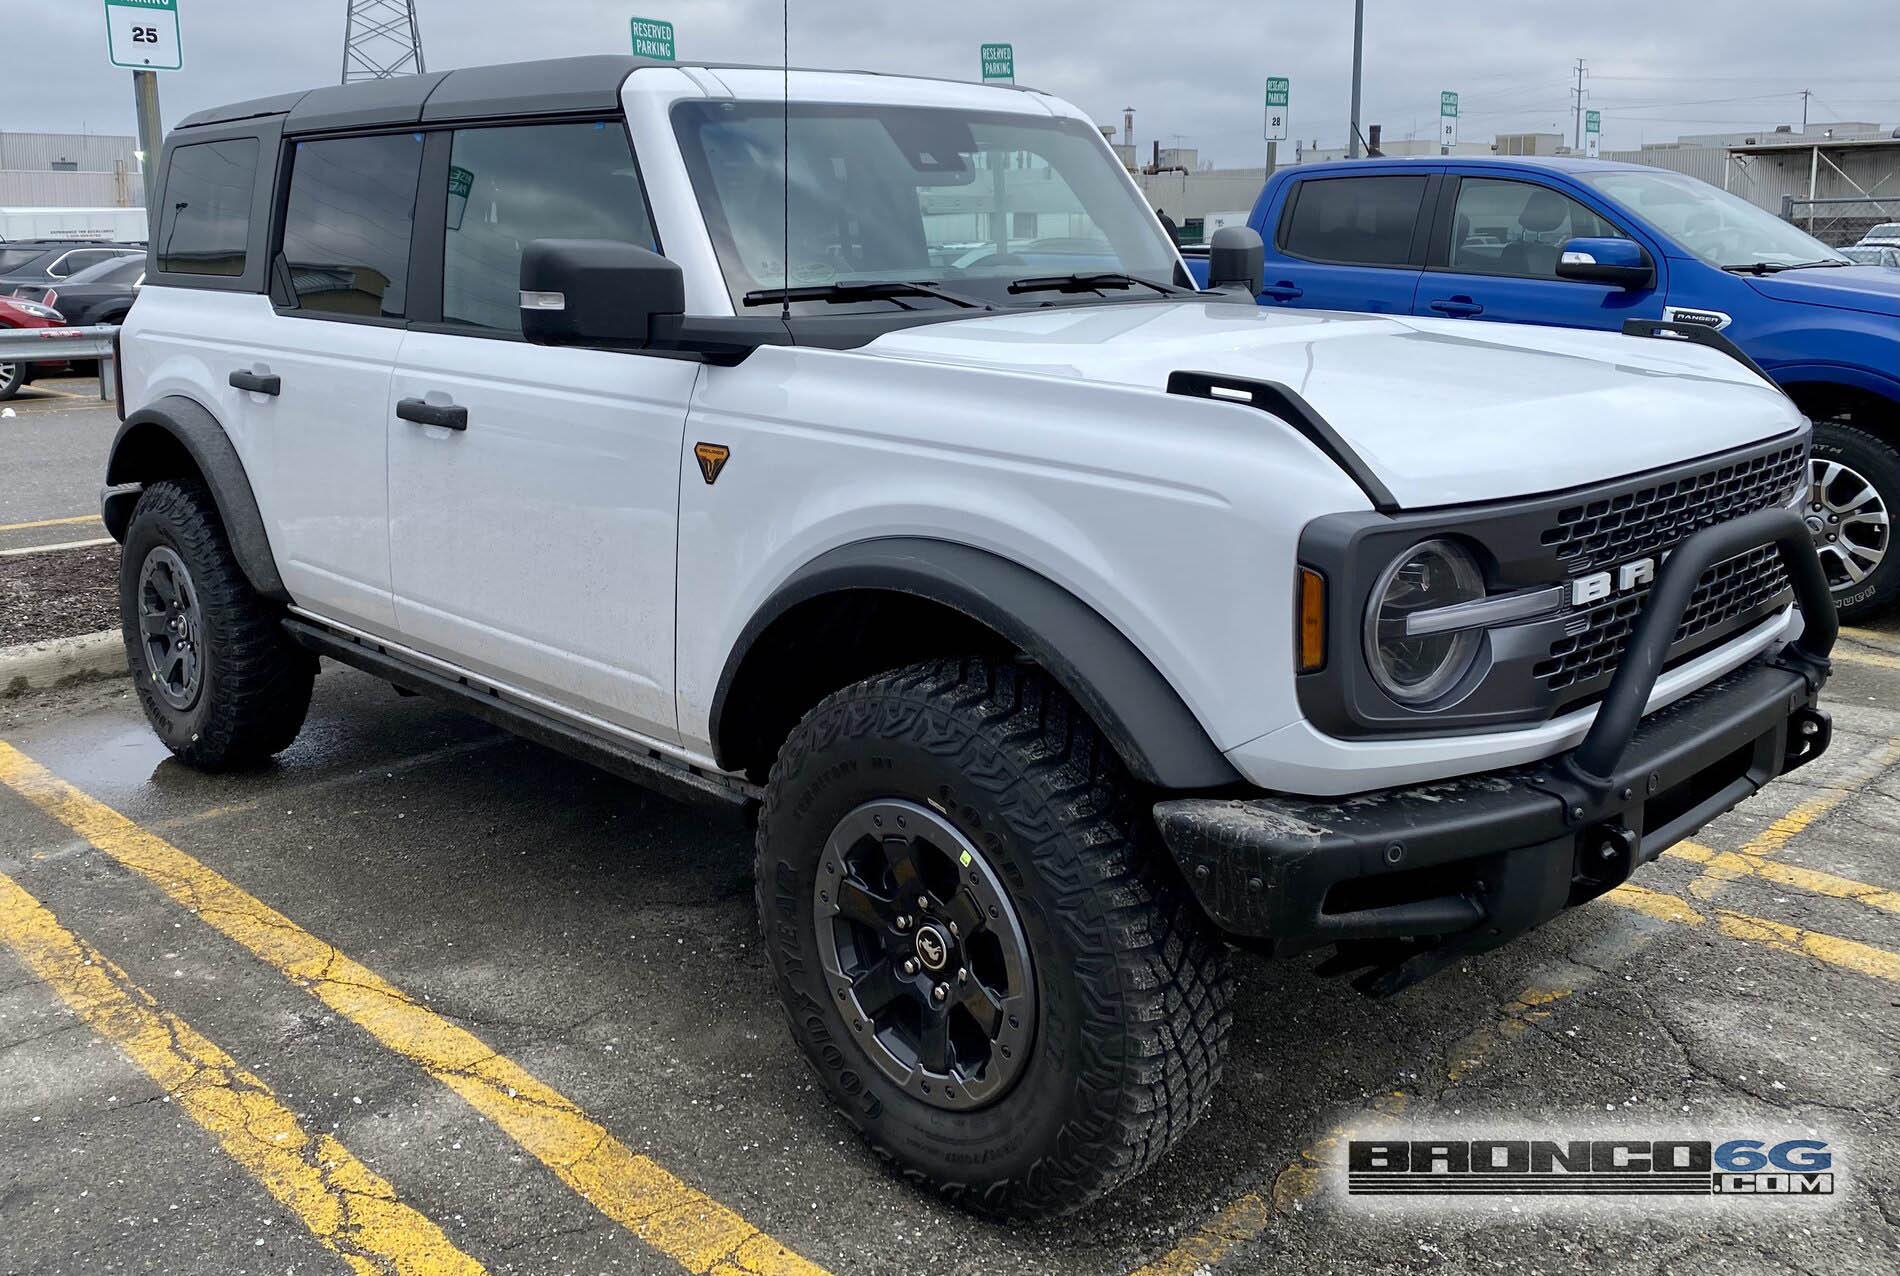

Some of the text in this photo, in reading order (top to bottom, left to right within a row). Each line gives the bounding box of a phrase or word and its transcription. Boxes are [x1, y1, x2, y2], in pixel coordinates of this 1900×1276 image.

[132, 26, 158, 43] 25
[633, 22, 672, 40] RESERVED
[636, 39, 671, 57] PARKING
[982, 47, 1011, 60] RESERVED
[985, 62, 1010, 75] PARKING
[1272, 117, 1281, 126] 28
[1677, 313, 1719, 323] RANGER
[1571, 550, 1672, 606] BR
